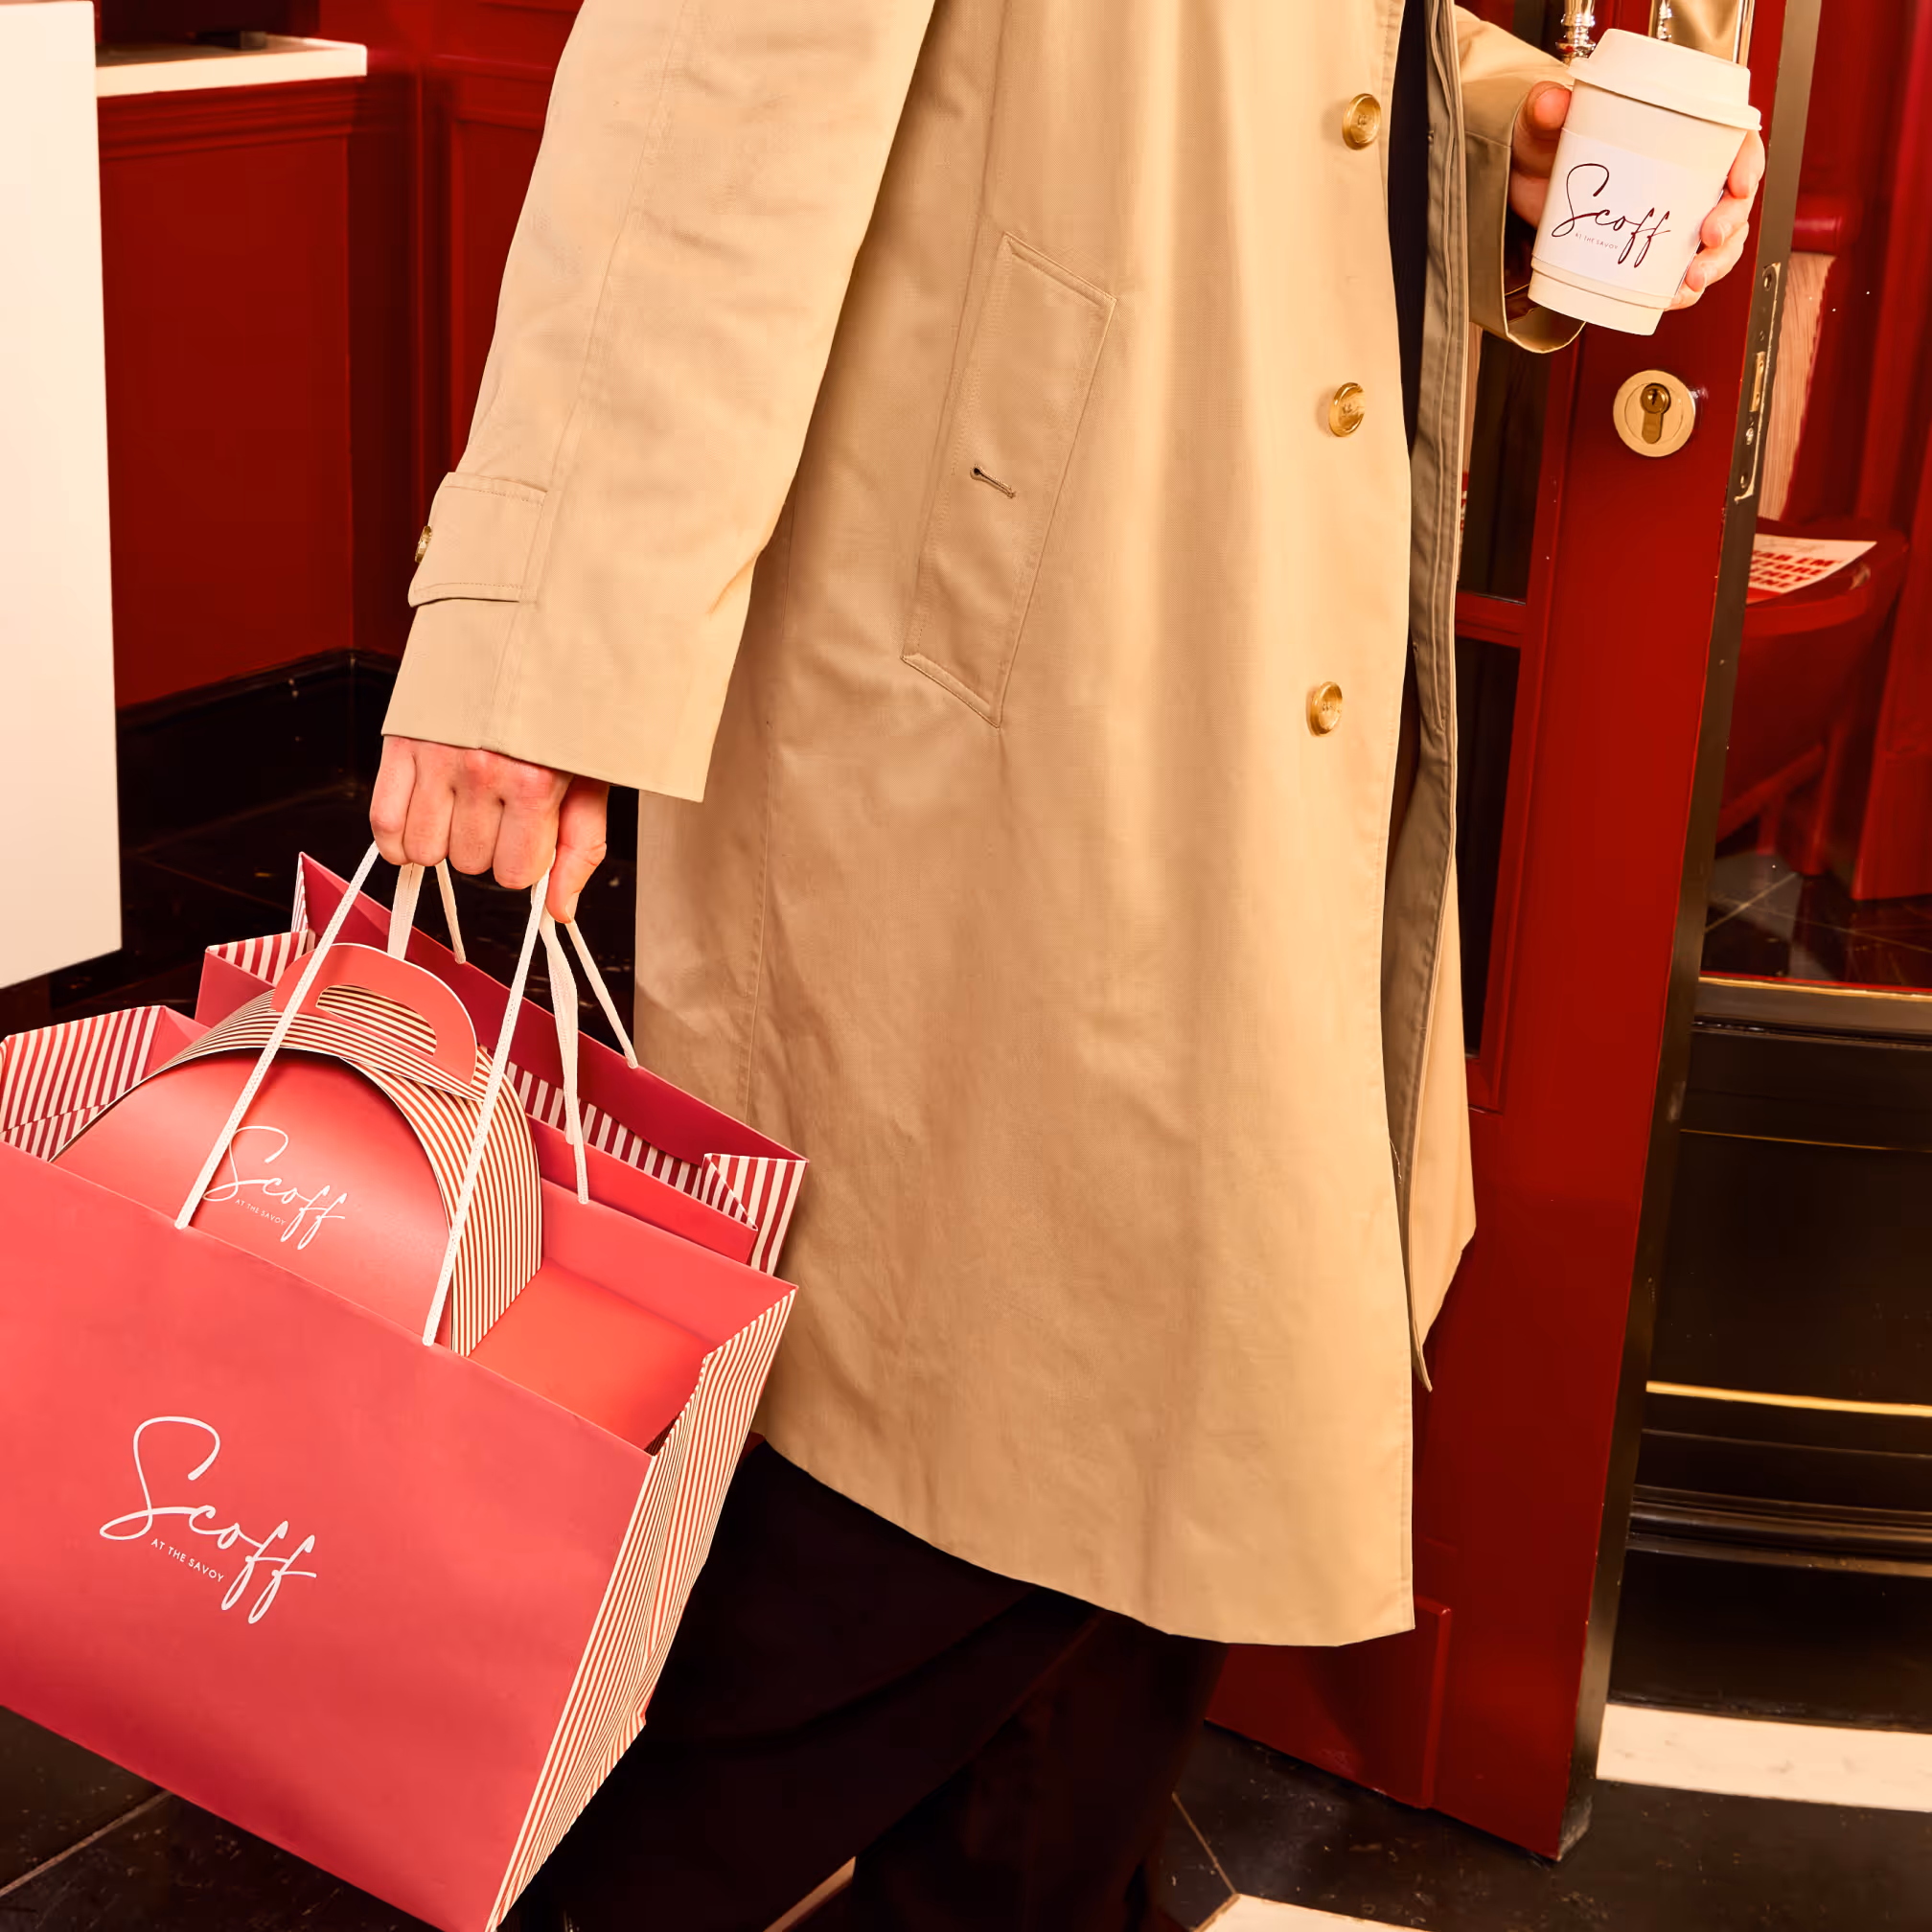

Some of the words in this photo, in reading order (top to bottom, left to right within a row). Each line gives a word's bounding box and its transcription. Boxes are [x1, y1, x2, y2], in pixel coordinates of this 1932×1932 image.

[1552, 163, 1670, 267] Scoff
[1583, 234, 1595, 243] THE
[1596, 239, 1618, 250] SAVOY
[203, 1125, 347, 1250] Scoff
[235, 1198, 245, 1207] AT
[245, 1202, 260, 1214] THE
[260, 1209, 287, 1226] SAVOY
[100, 1415, 317, 1624] Scoff
[150, 1538, 166, 1551] AT
[168, 1546, 187, 1563] THE
[188, 1558, 225, 1582] SAVOY
